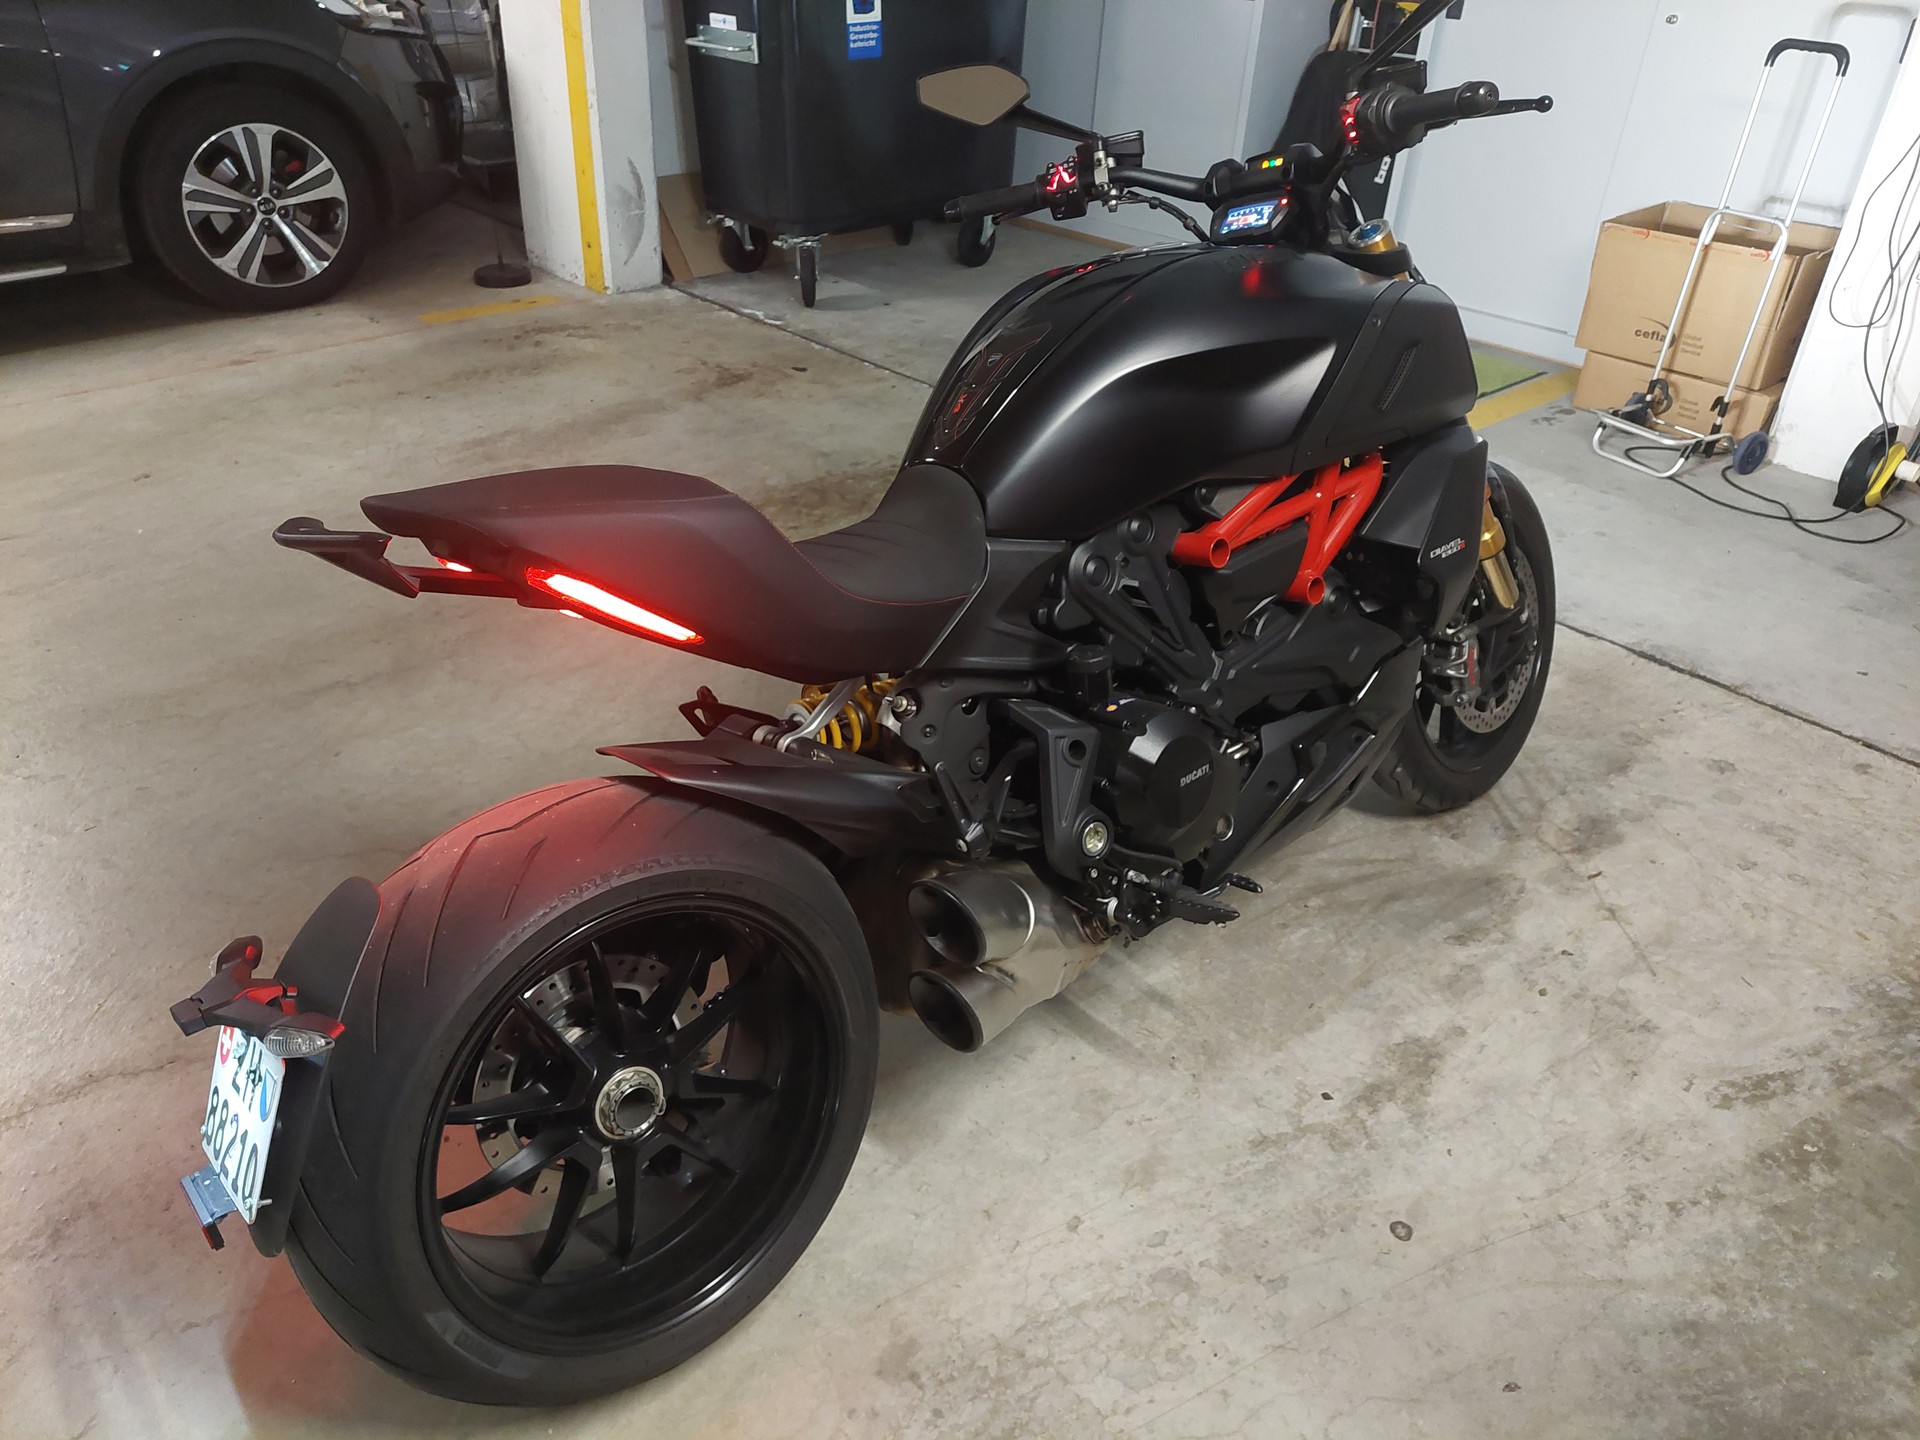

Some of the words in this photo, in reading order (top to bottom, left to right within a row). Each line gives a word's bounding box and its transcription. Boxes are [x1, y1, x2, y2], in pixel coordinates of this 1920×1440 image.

[849, 24, 880, 32] Industrie-
[849, 32, 880, 40] Gewerbe-
[1634, 328, 1667, 343] cefla
[1430, 538, 1465, 558] DIAVEL
[1180, 764, 1209, 787] DUCATI
[205, 1085, 258, 1202] 88210
